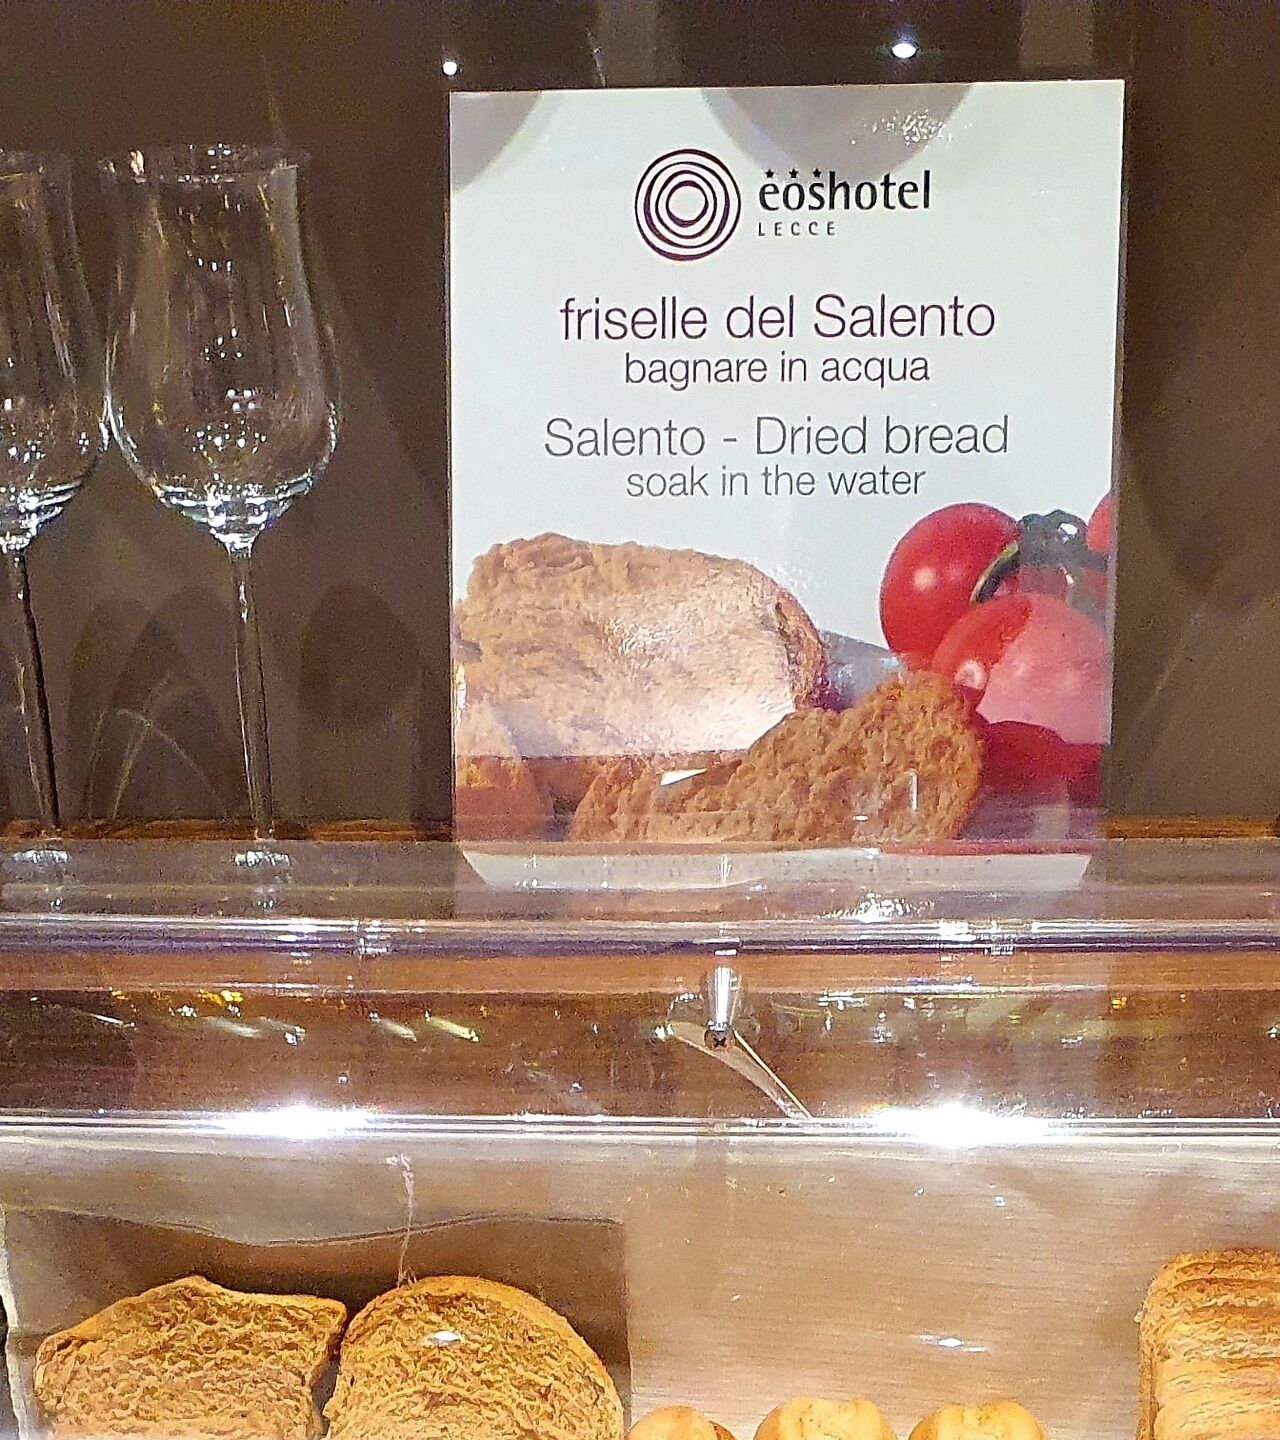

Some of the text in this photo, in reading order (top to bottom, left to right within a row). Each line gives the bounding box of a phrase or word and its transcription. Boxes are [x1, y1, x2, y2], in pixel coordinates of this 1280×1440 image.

[759, 168, 931, 211] eoshotel
[758, 221, 837, 237] LECCE
[559, 293, 995, 341] friselle del Salento
[625, 352, 930, 391] bagnare in acqua
[545, 417, 705, 457] Salento
[757, 415, 867, 455] Dried
[886, 414, 1008, 456] bread
[627, 464, 926, 497] soak in the water
